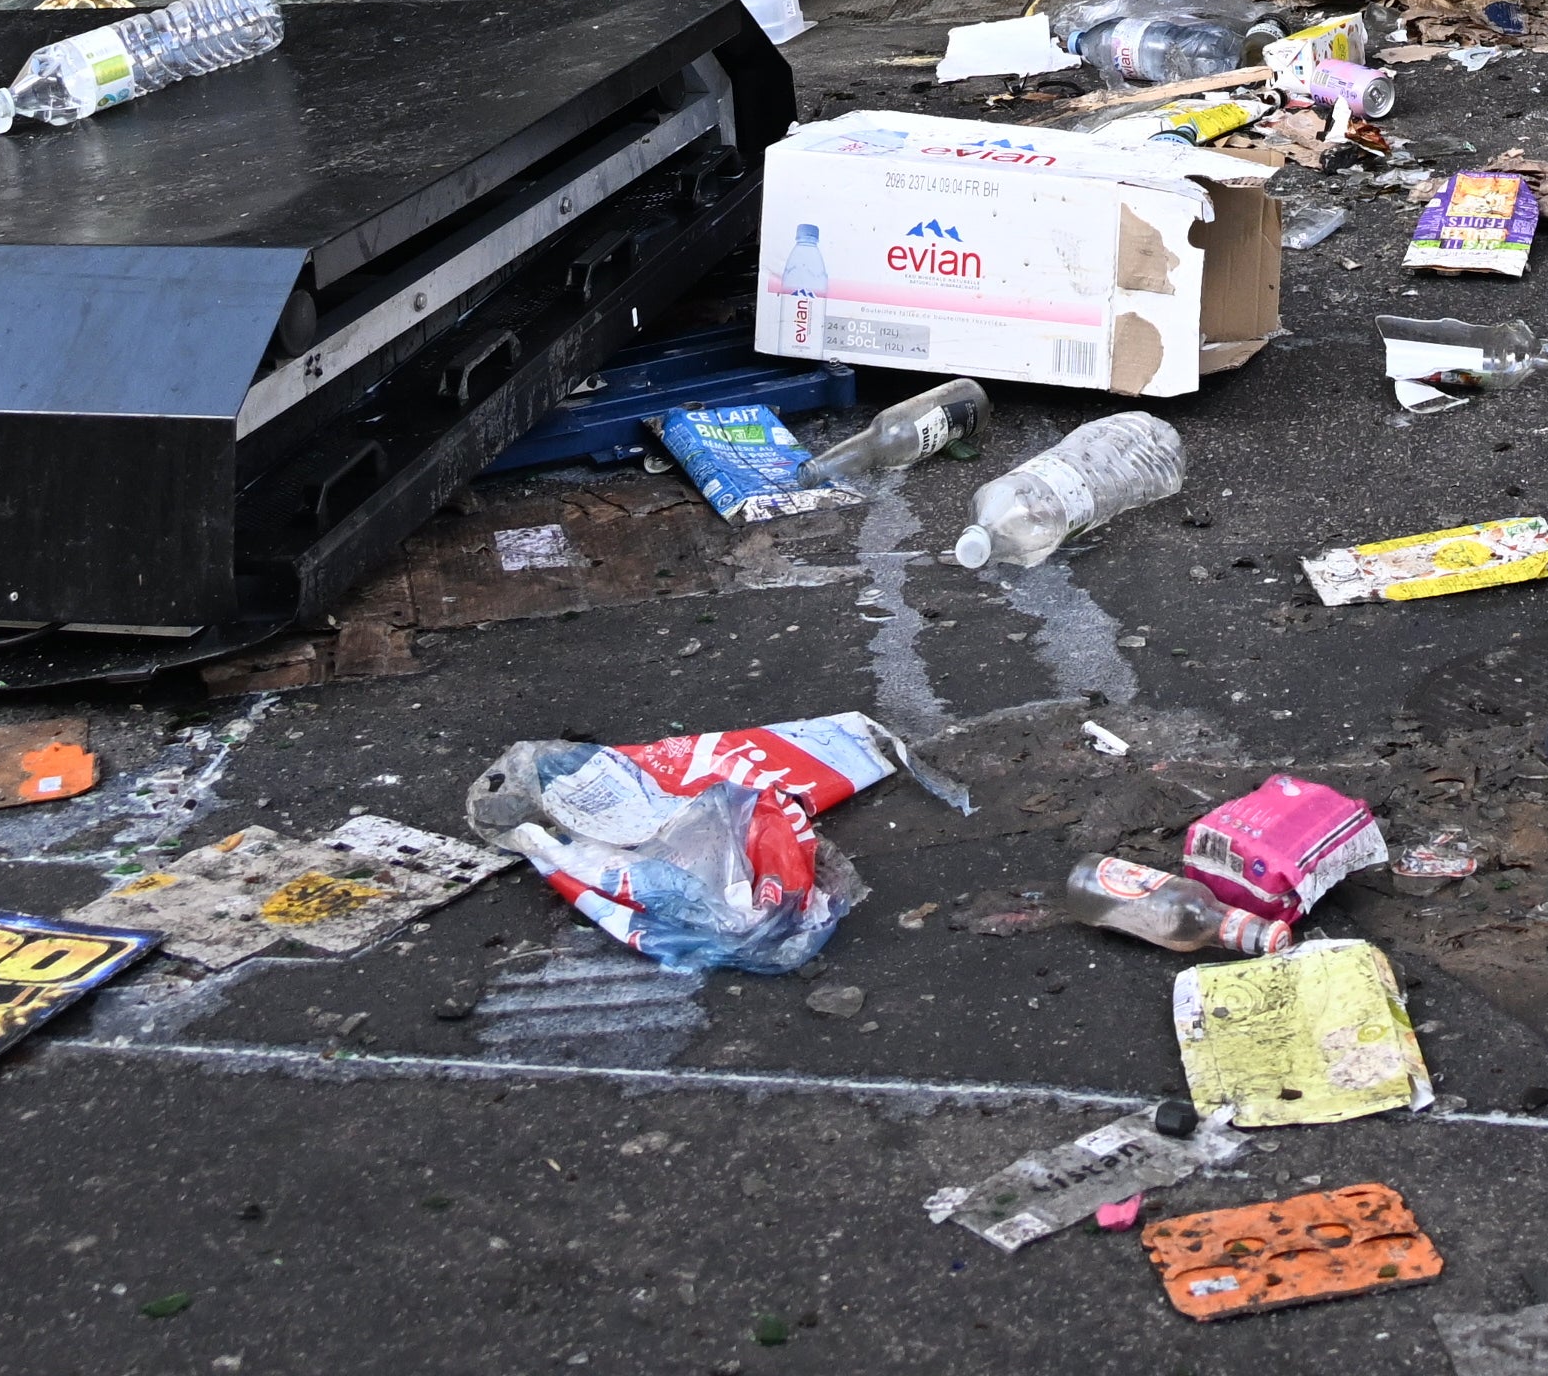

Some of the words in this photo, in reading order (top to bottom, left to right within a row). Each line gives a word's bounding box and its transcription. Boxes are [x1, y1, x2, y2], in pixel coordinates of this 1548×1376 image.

[1122, 47, 1132, 77] vian
[920, 147, 1058, 167] evian
[885, 171, 906, 189] 2026
[908, 174, 926, 192] 237
[926, 177, 937, 193] L4
[964, 179, 980, 197] FR
[982, 181, 1000, 199] BH
[887, 243, 982, 279] evian
[795, 298, 808, 344] evian
[826, 322, 838, 331] 24
[847, 320, 876, 335] 0,5L
[879, 328, 900, 339] (12L)
[826, 336, 838, 345] 24
[846, 334, 881, 350] 50cL
[884, 342, 905, 353] (12L)
[686, 411, 712, 423] CE
[717, 408, 760, 425] LAIT
[694, 424, 733, 443] BIO
